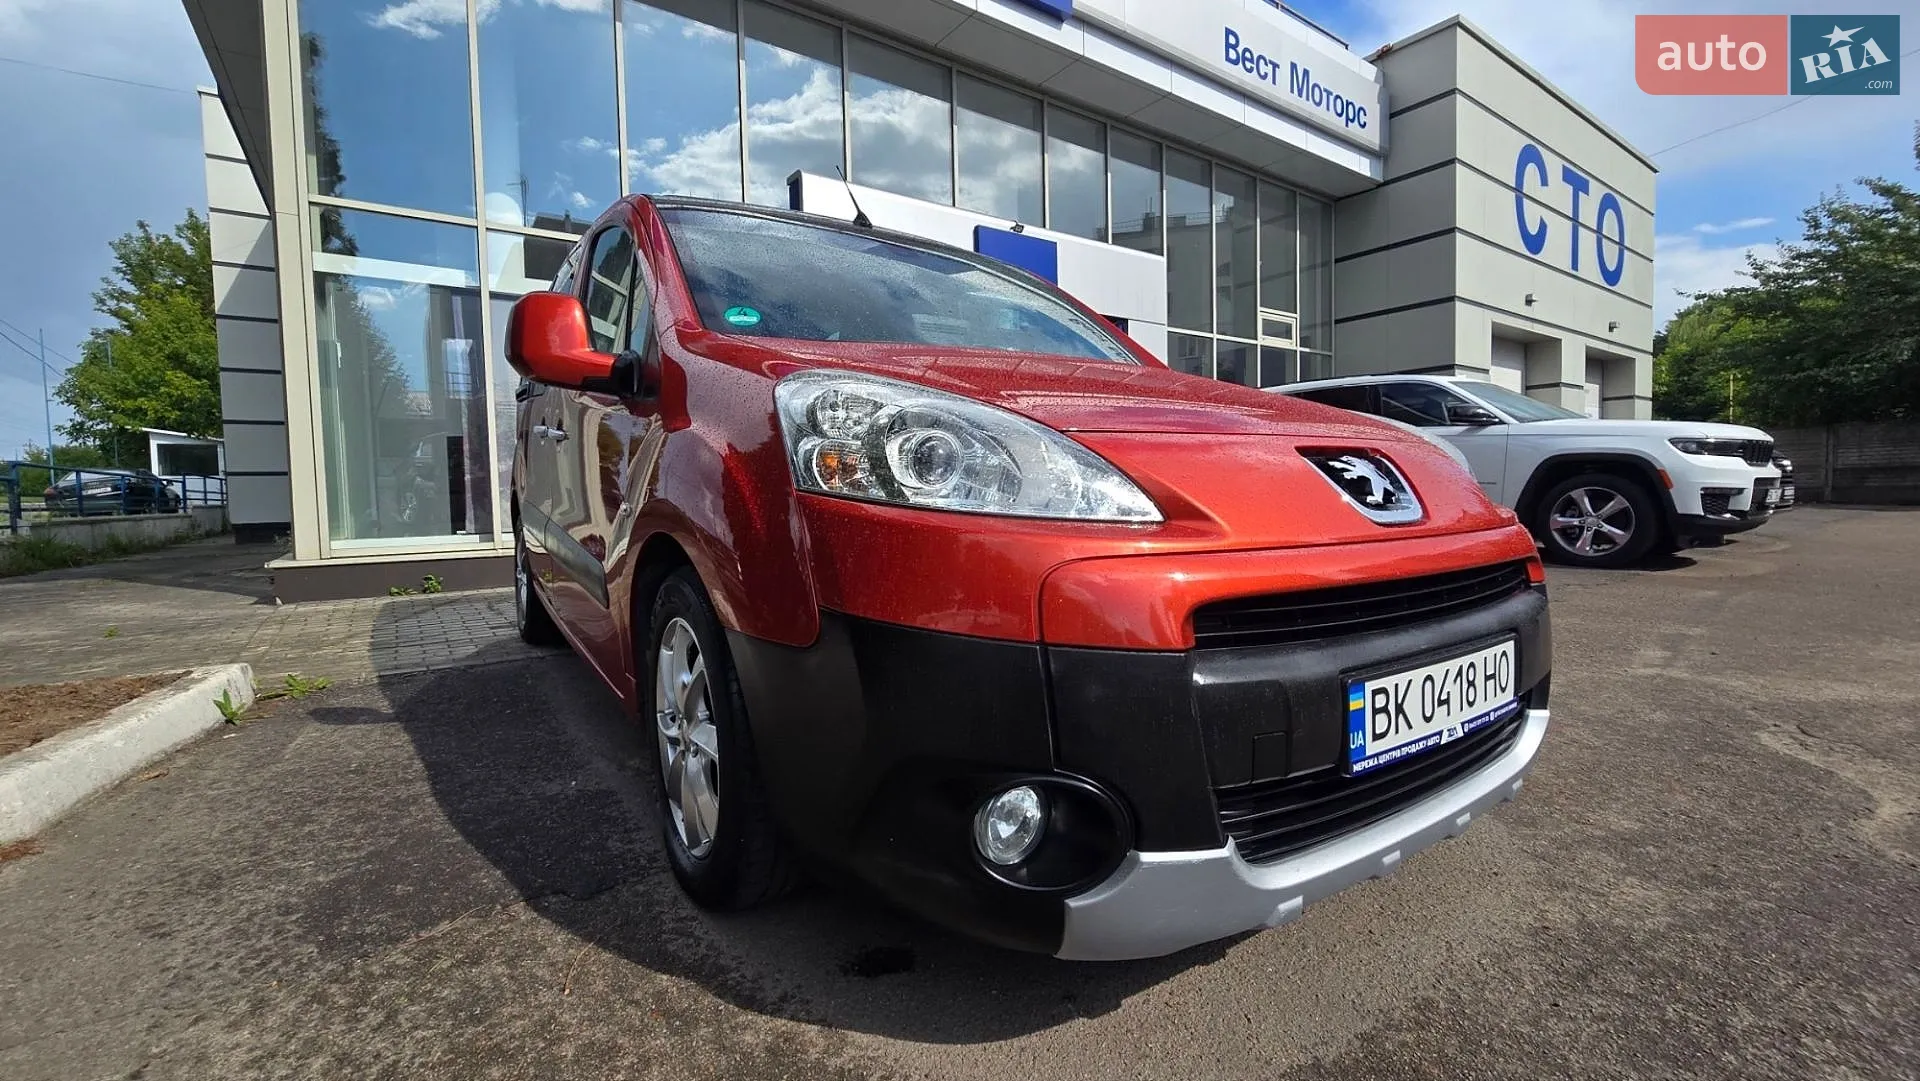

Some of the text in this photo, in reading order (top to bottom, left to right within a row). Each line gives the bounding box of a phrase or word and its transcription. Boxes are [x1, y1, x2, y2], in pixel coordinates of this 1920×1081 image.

[1224, 26, 1367, 129] Вест Моторс
[1514, 143, 1625, 287] СТО
[1349, 733, 1365, 749] UA
[1371, 650, 1510, 743] BK 0418 HO
[1353, 758, 1378, 773] МЕРЕЖА
[1400, 740, 1427, 757] ПРОДАЖУ
[1427, 735, 1440, 746] АВТО
